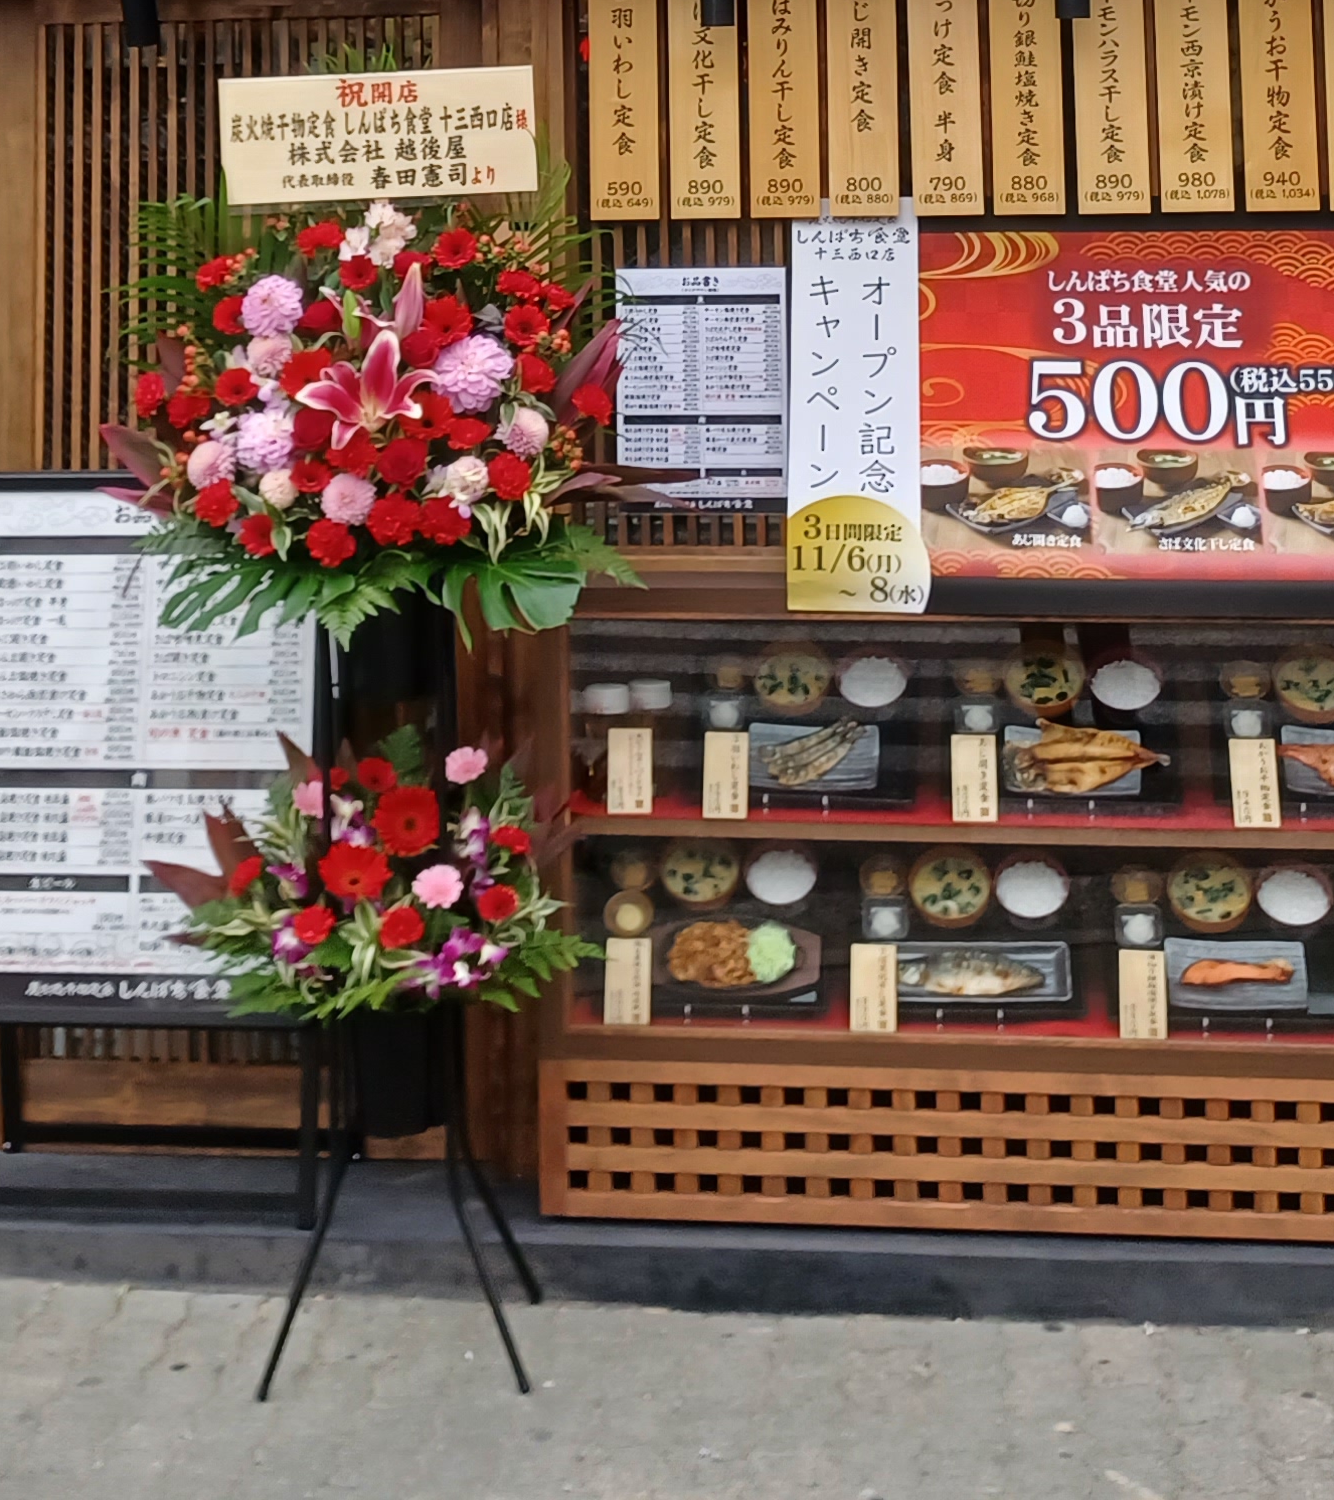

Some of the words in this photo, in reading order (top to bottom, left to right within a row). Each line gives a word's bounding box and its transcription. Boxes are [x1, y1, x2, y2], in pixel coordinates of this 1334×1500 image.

[336, 79, 418, 108] 祝開店
[230, 110, 336, 143] 炭火焼干物定食
[344, 107, 432, 135] しんぱち食堂
[439, 103, 527, 132] 十三西口店様
[934, 112, 955, 163] 半身
[289, 139, 385, 166] 株式会社
[395, 135, 466, 160] 越後屋
[282, 173, 354, 188] 代表取締役
[688, 180, 723, 194] 890
[767, 178, 803, 194] 890
[846, 177, 882, 192] 800
[929, 177, 966, 192] 790
[1011, 176, 1047, 191] 880
[1095, 174, 1132, 188] 890
[1178, 172, 1215, 187] 980
[1263, 172, 1301, 186] 940
[606, 181, 642, 196] 590
[797, 227, 910, 244] しんぱち食堂
[815, 247, 895, 261] 十三西口店
[1048, 270, 1251, 293] しんぱち食堂人気の
[1052, 299, 1243, 350] 3品限定
[807, 276, 840, 489] キャンペーン
[859, 276, 895, 494] オープン記念
[1027, 358, 1288, 445] 500円
[803, 514, 902, 542] 3日間限定
[1012, 535, 1082, 548] あじ開き定食
[792, 545, 902, 574] 11/6(月)
